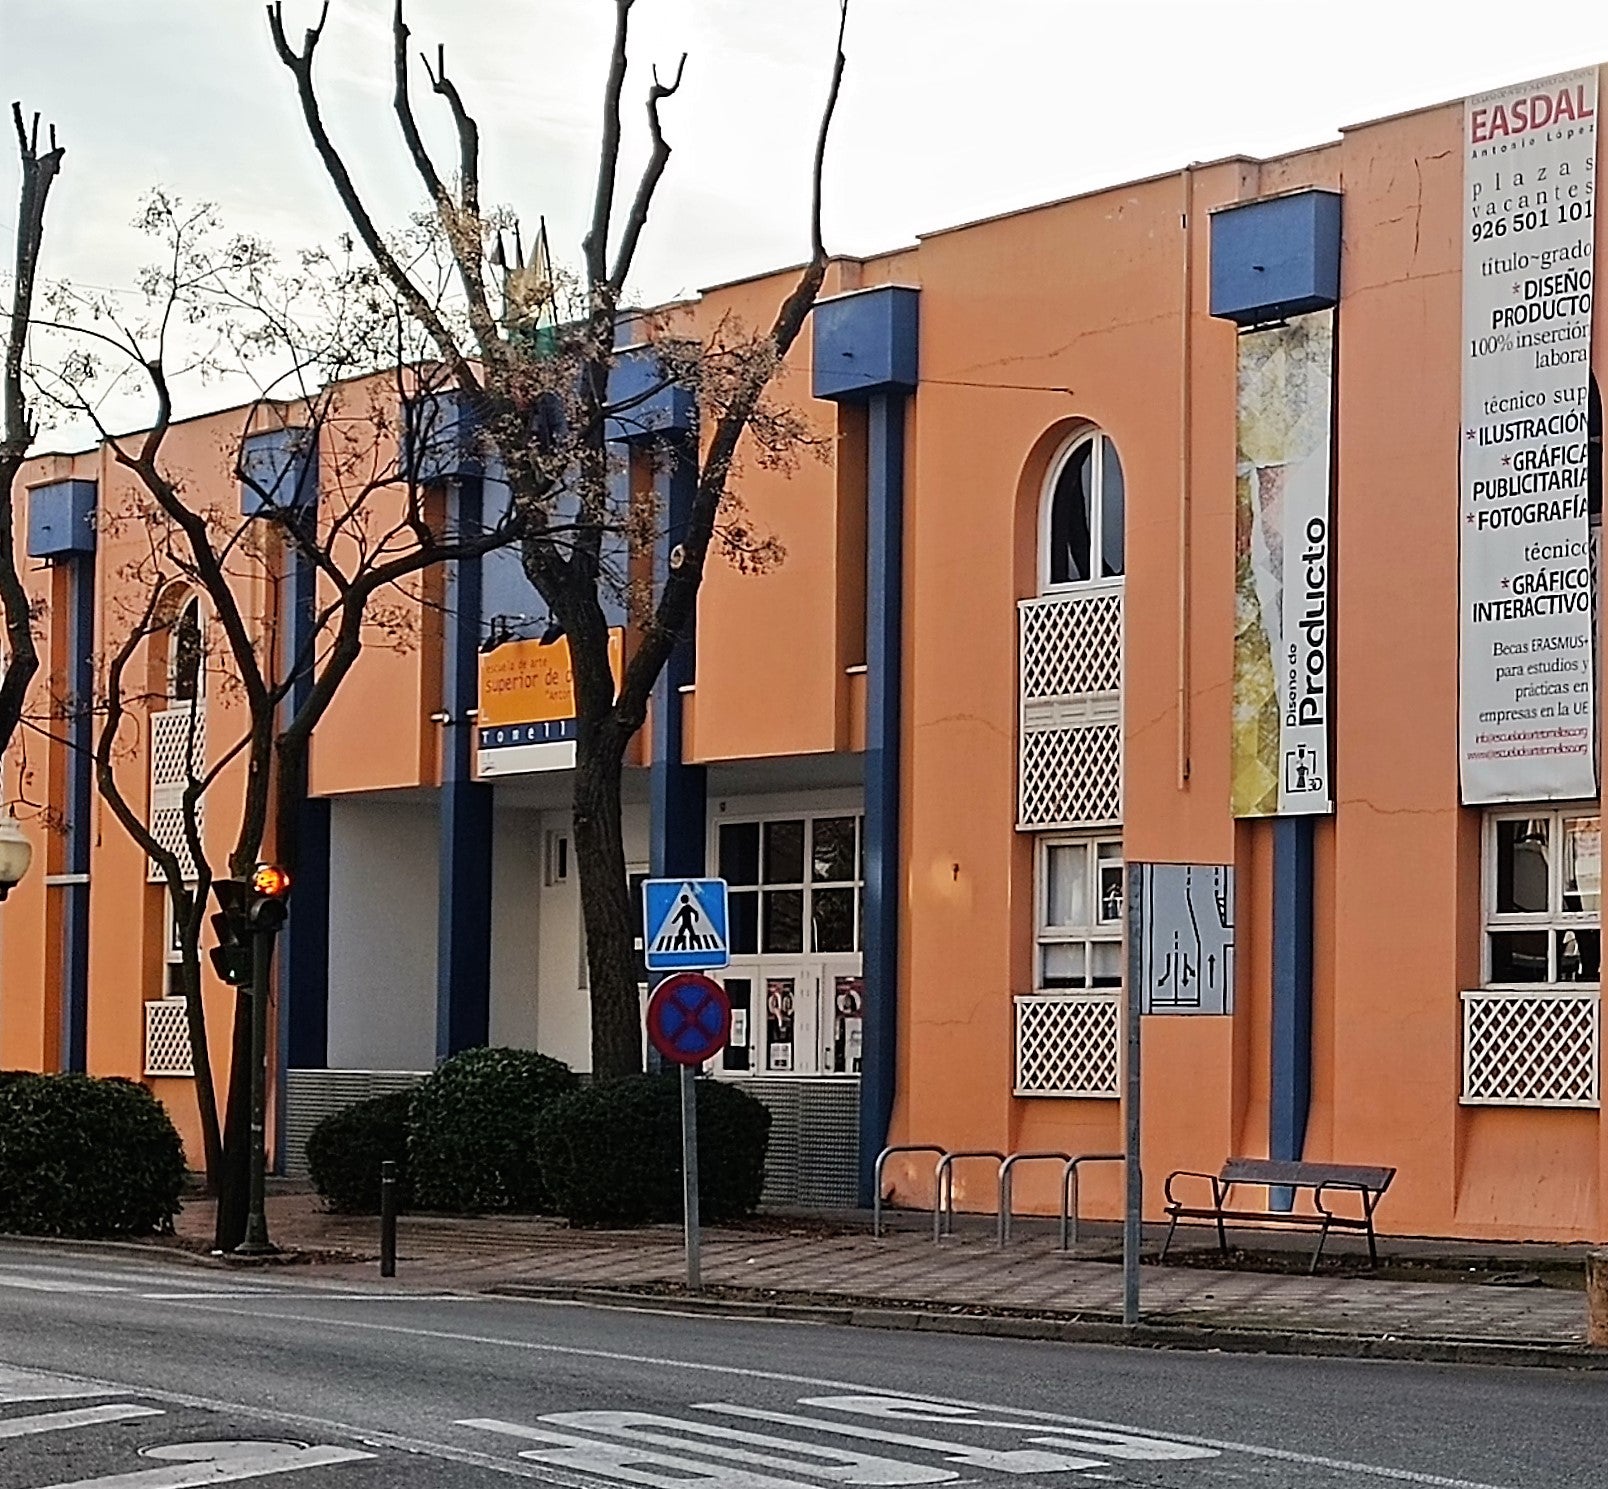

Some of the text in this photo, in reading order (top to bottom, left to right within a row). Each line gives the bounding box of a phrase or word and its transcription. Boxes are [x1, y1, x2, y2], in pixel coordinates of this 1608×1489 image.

[1471, 84, 1594, 144] EASDAL
[1472, 138, 1535, 159] Antonio
[1473, 157, 1593, 202] plazas
[1472, 181, 1593, 218] vacantes
[1472, 199, 1592, 243] 926 501 101
[1524, 268, 1591, 301] DISEÑO
[1492, 294, 1591, 330] PRODUCTO
[1471, 334, 1514, 358] 100%
[1484, 390, 1546, 415] técnico
[1512, 567, 1589, 595] GRÁFICO
[1298, 517, 1326, 727] Producto
[1472, 591, 1589, 623] INTERACTIVO
[1493, 642, 1528, 657] Becas
[486, 671, 539, 695] superior
[545, 668, 558, 685] de
[1496, 658, 1589, 681] para estudios y
[1573, 681, 1589, 693] en
[1479, 707, 1537, 725] empresas
[1573, 702, 1589, 715] UE
[452, 1395, 1222, 1489] STOP
